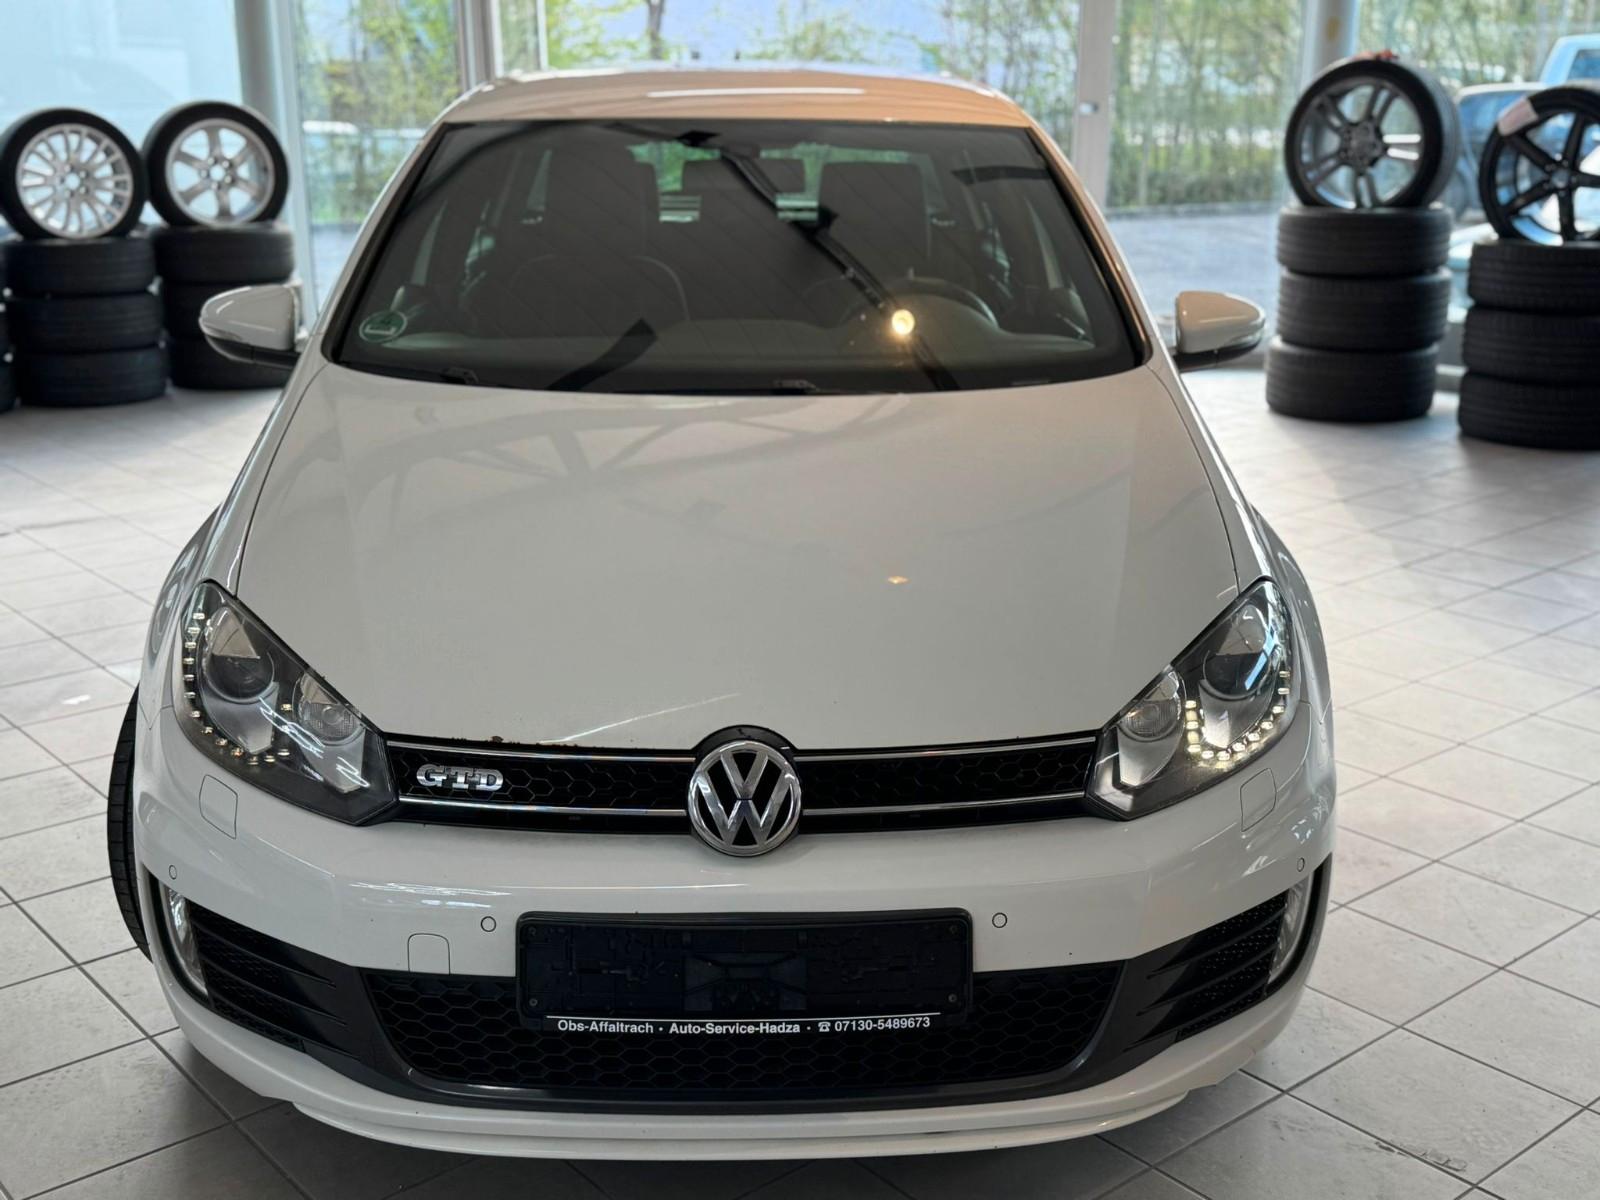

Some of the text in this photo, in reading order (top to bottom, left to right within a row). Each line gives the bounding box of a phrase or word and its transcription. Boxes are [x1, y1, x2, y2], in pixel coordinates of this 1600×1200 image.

[416, 763, 504, 792] GTD
[557, 1016, 931, 1034] Obs-Affaltrach Auto-Service-Hadza 07130-5489673
